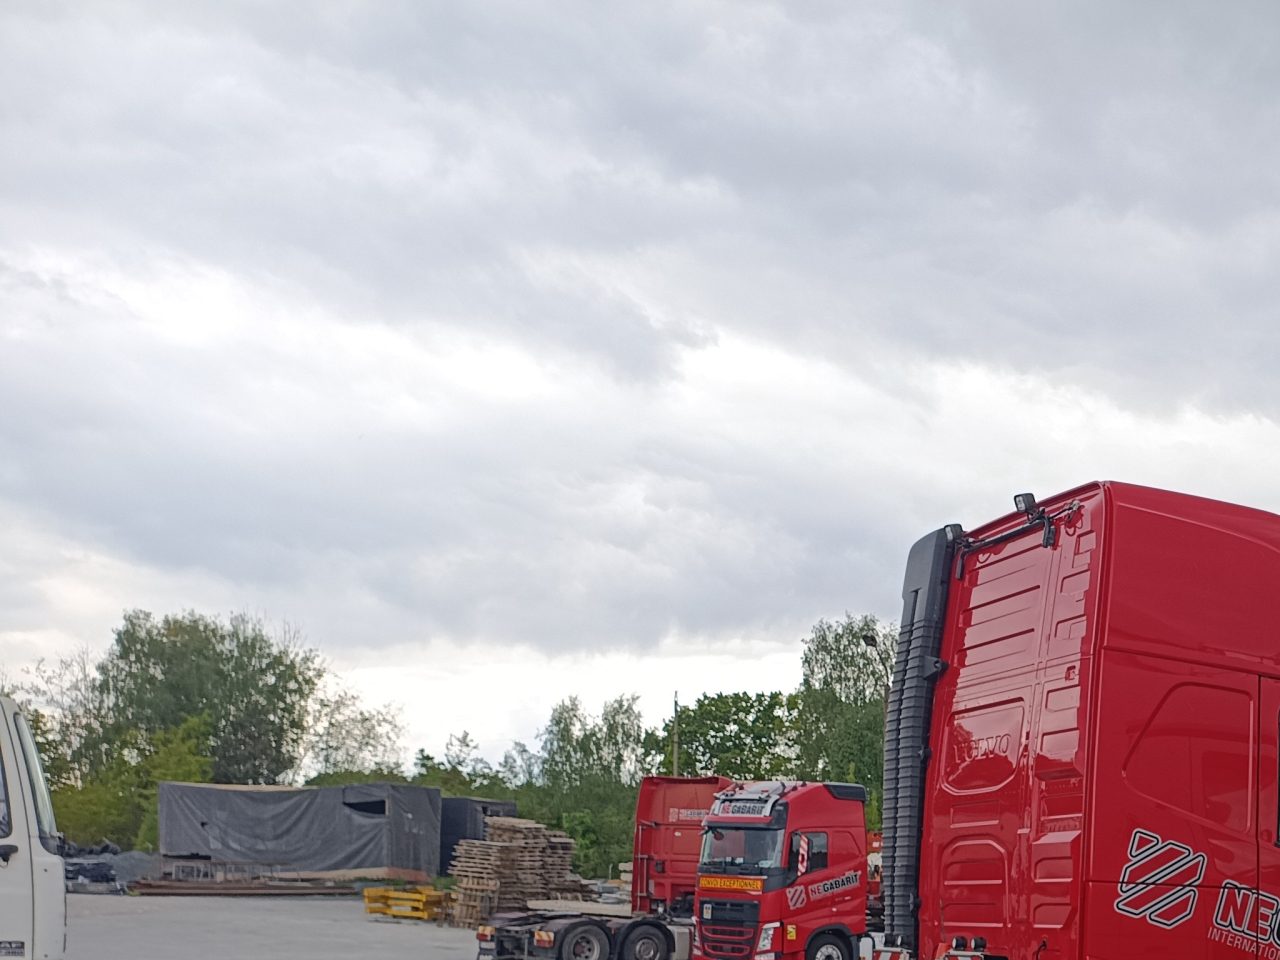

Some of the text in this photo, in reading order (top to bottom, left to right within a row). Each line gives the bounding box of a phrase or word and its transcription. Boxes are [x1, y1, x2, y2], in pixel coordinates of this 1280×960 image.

[953, 733, 1011, 764] VOLVO
[720, 803, 765, 815] NEGABARIT
[809, 873, 859, 898] NEGABARIT
